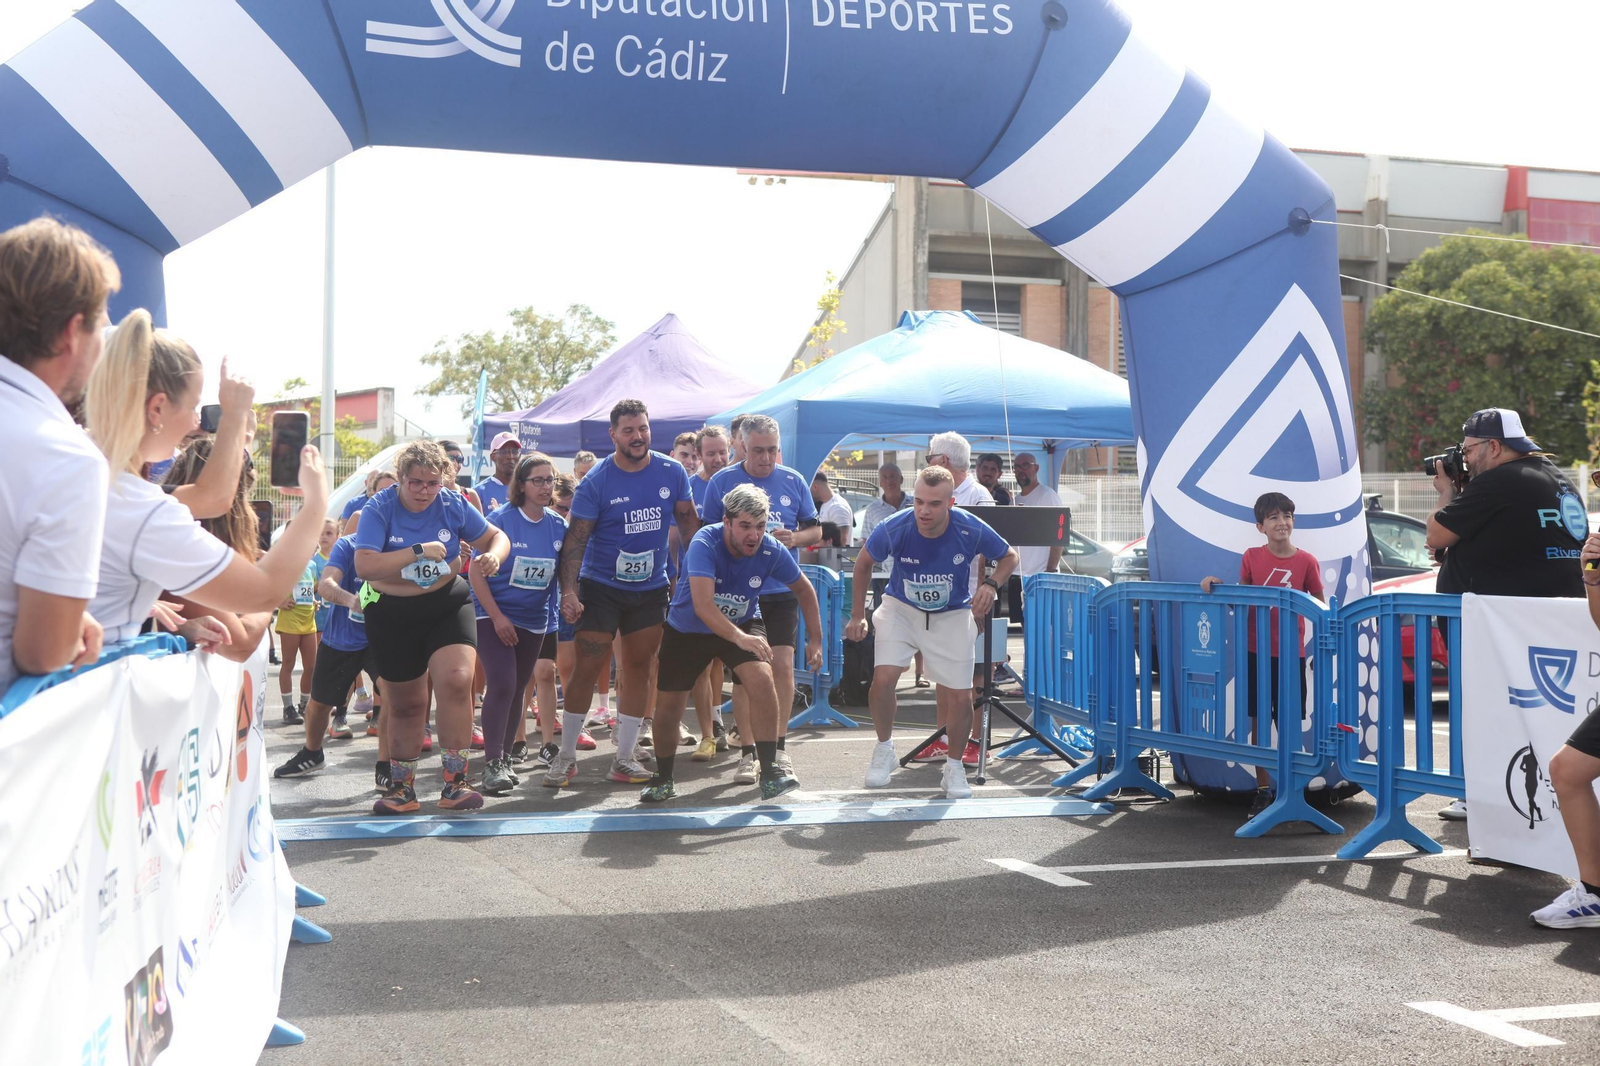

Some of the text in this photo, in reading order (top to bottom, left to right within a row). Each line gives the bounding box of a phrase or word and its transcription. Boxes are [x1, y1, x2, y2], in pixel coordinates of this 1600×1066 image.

[812, 0, 1013, 35] DEPORTES
[545, 30, 729, 82] de Cádiz
[521, 422, 541, 436] Diputación
[630, 507, 661, 522] CROSS
[627, 520, 660, 533] INCLUSIVO
[414, 565, 440, 578] 164
[524, 567, 545, 579] 174
[625, 561, 647, 573] 251
[301, 587, 313, 597] 26
[915, 591, 940, 602] 169
[716, 604, 738, 617] 66
